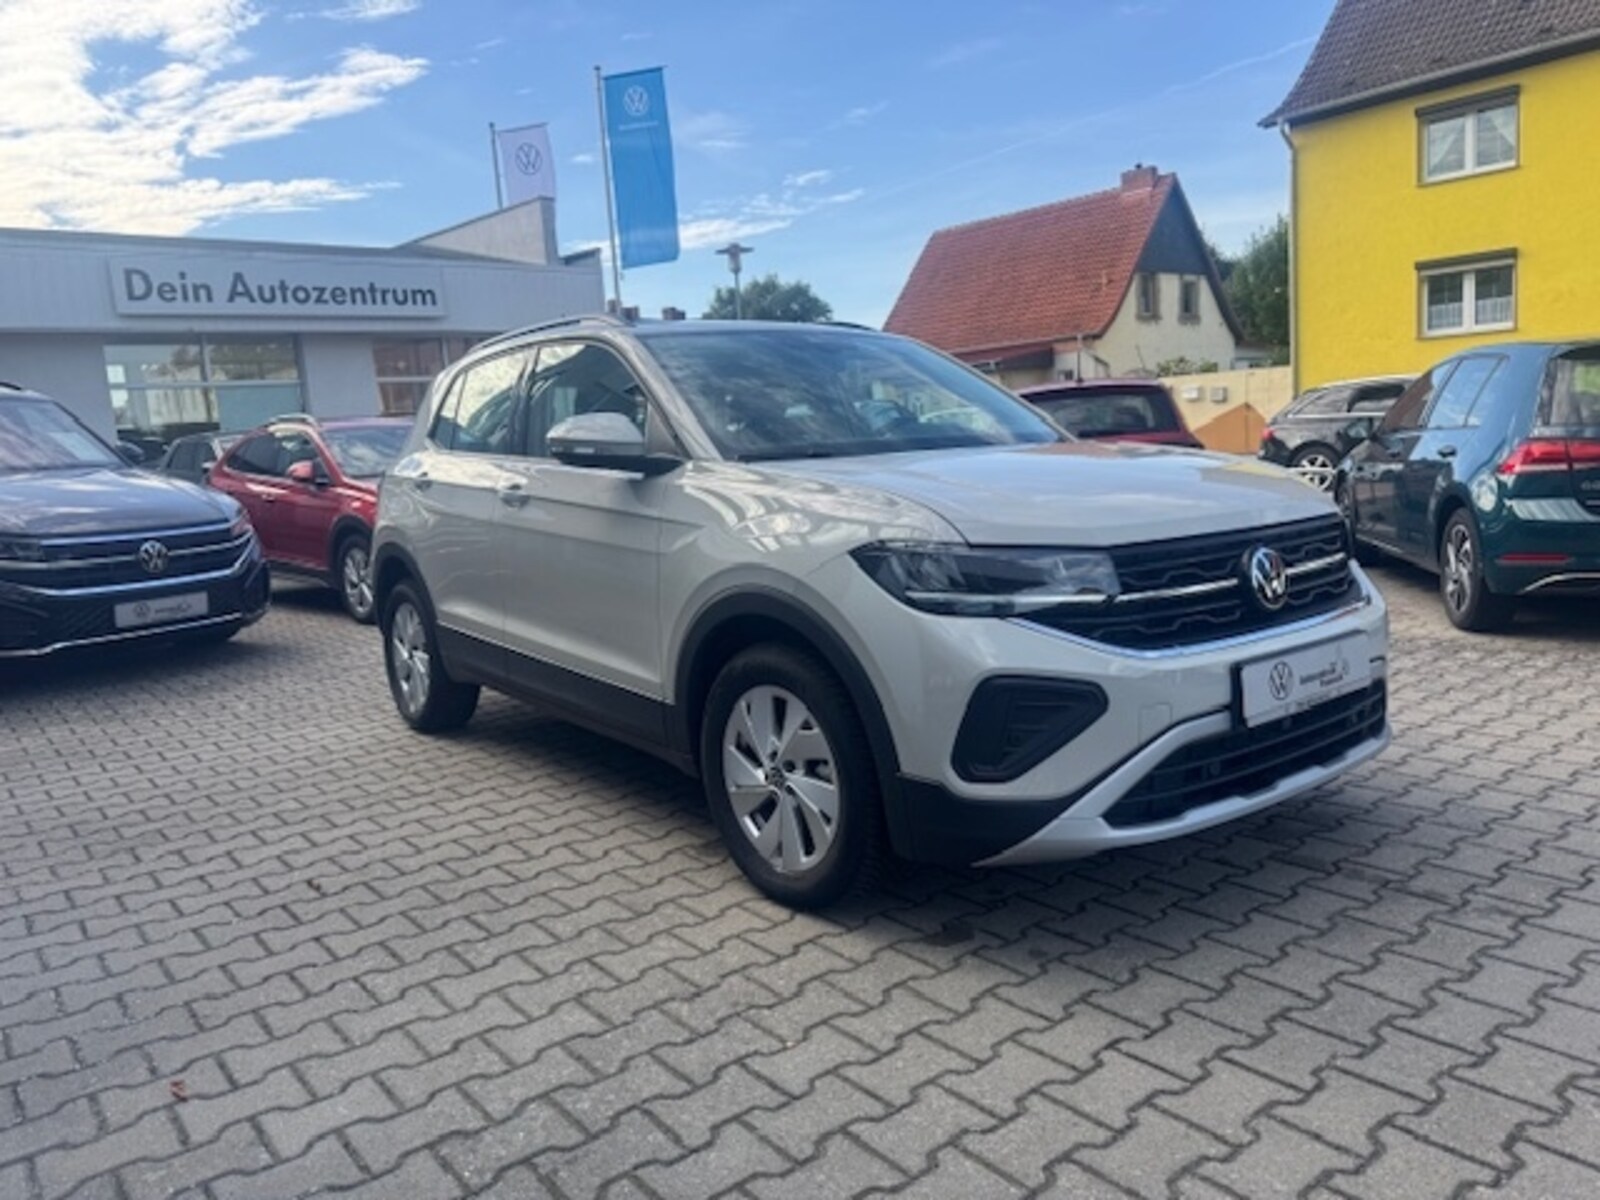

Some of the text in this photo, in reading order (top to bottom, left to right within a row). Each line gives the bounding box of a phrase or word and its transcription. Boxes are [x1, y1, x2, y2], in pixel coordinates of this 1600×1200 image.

[514, 142, 543, 175] VW
[122, 267, 438, 306] Dein Autozentrum
